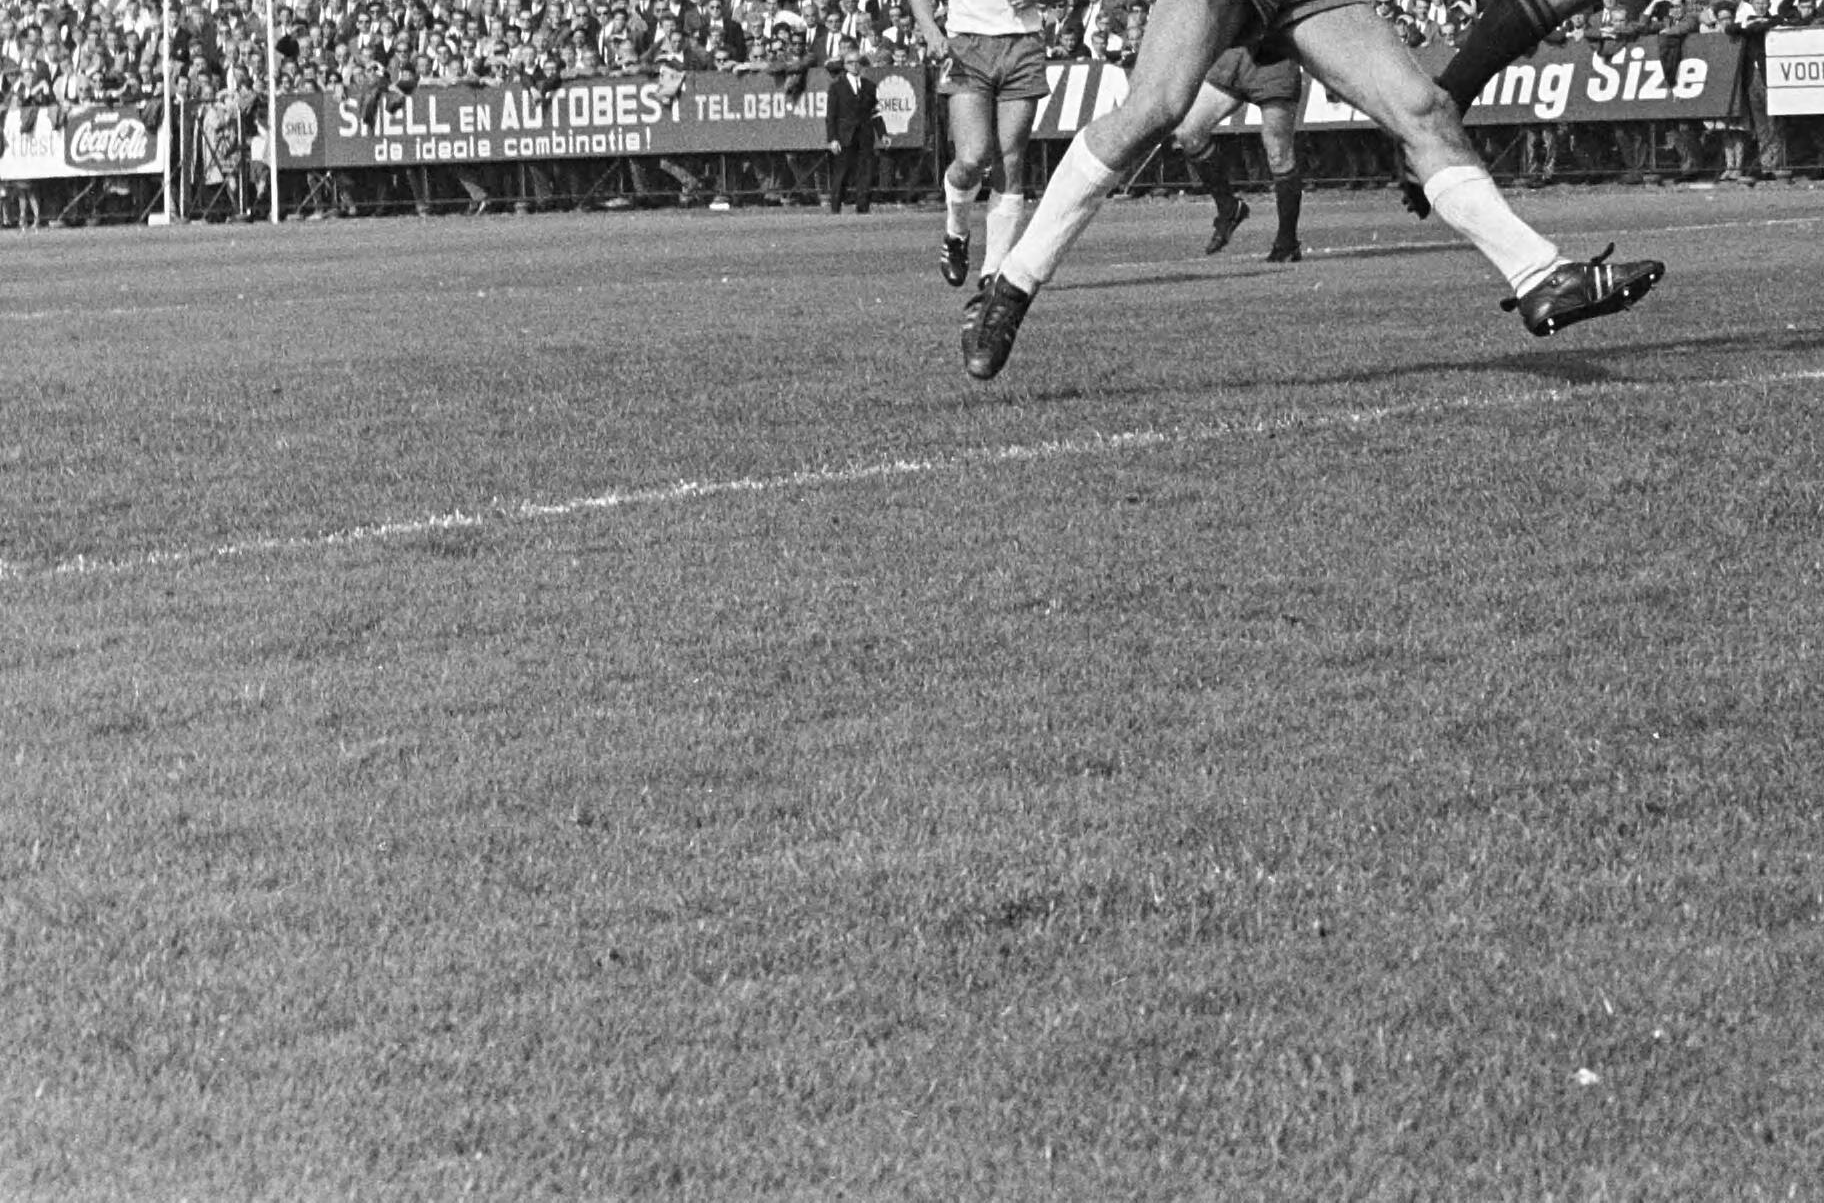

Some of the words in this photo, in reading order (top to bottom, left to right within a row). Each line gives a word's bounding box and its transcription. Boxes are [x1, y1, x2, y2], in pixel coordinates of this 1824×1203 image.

[1586, 47, 1708, 102] Size
[460, 104, 490, 132] EN
[71, 119, 147, 163] Coca-Cola
[375, 138, 402, 161] de
[416, 136, 490, 160] ideale
